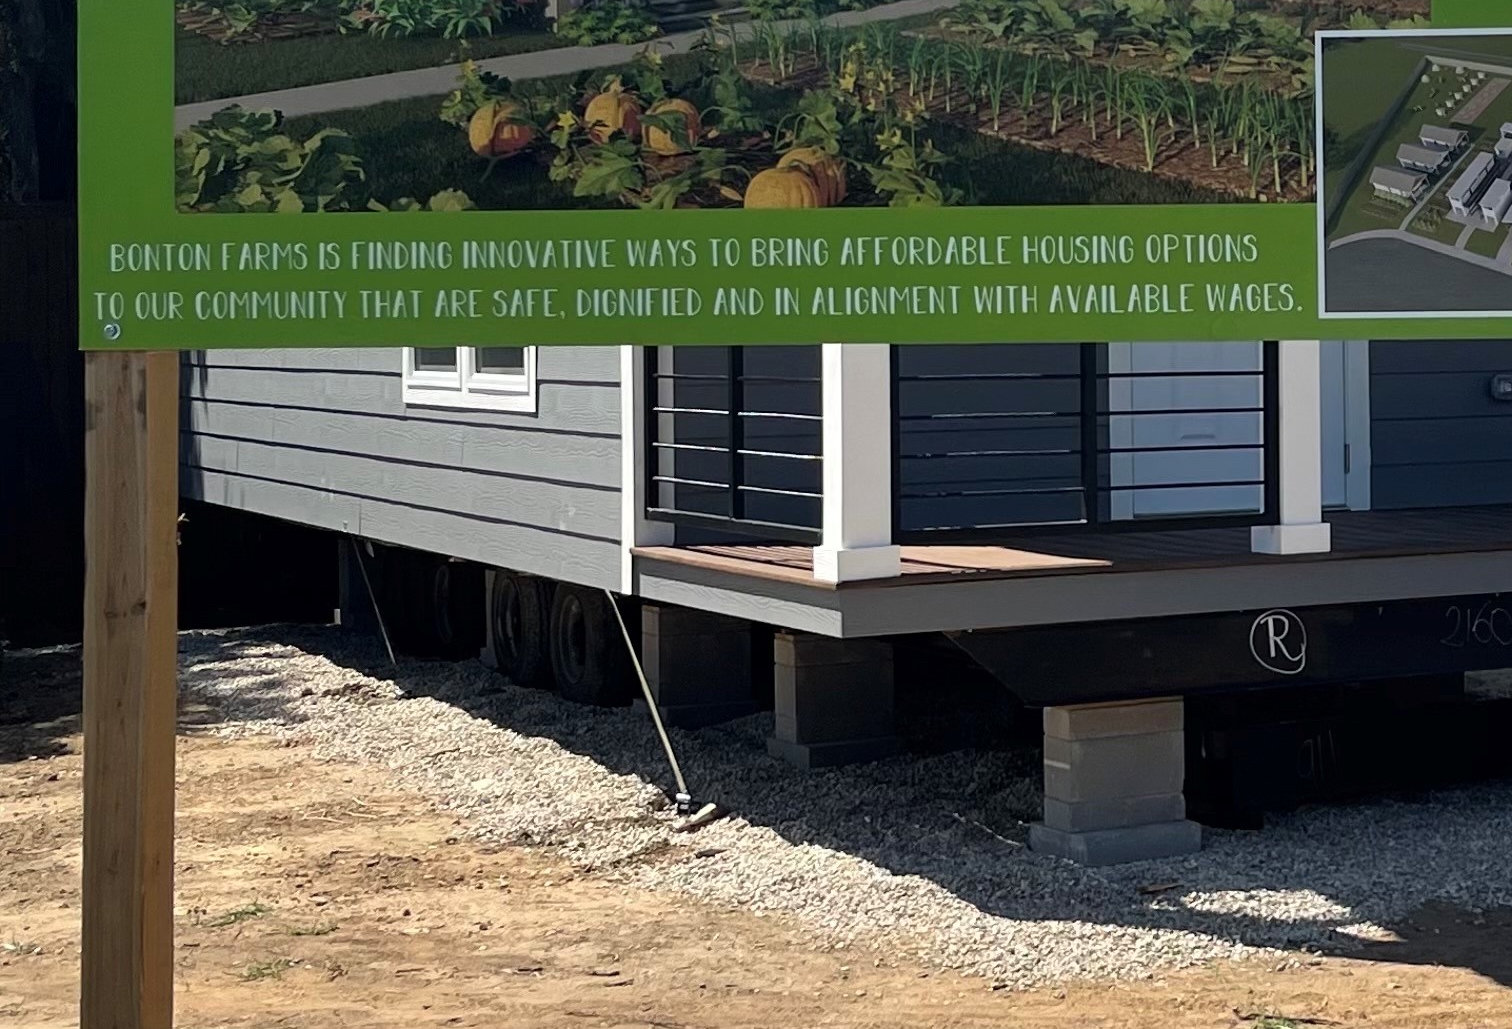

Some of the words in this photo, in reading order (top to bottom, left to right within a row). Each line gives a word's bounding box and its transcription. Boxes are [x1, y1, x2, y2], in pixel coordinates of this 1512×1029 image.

[110, 243, 210, 272] BONTON
[221, 242, 308, 271] FARMS
[319, 242, 340, 270] IS
[351, 241, 452, 270] FINDING
[462, 239, 615, 269] INNOVATIVE
[626, 238, 697, 267] WAYS
[709, 238, 740, 267] TO
[751, 237, 829, 267] BRING
[840, 235, 1011, 266] AFFORDABLE
[1022, 235, 1134, 265] HOUSING
[1145, 233, 1258, 264] OPTIONS
[94, 292, 124, 321] TO
[135, 291, 183, 320] OUR
[195, 290, 345, 320] COMMUNITY
[359, 289, 420, 319] THAT
[434, 289, 482, 318] ARE
[492, 288, 565, 317] SAFE,
[576, 287, 702, 317] DIGNIFIED
[713, 287, 764, 316] AND
[775, 287, 800, 316] IN
[811, 285, 961, 316] ALIGNMENT
[973, 285, 1038, 315] WITH
[1049, 283, 1194, 314] AVAILABLE
[1205, 282, 1303, 312] WAGES.
